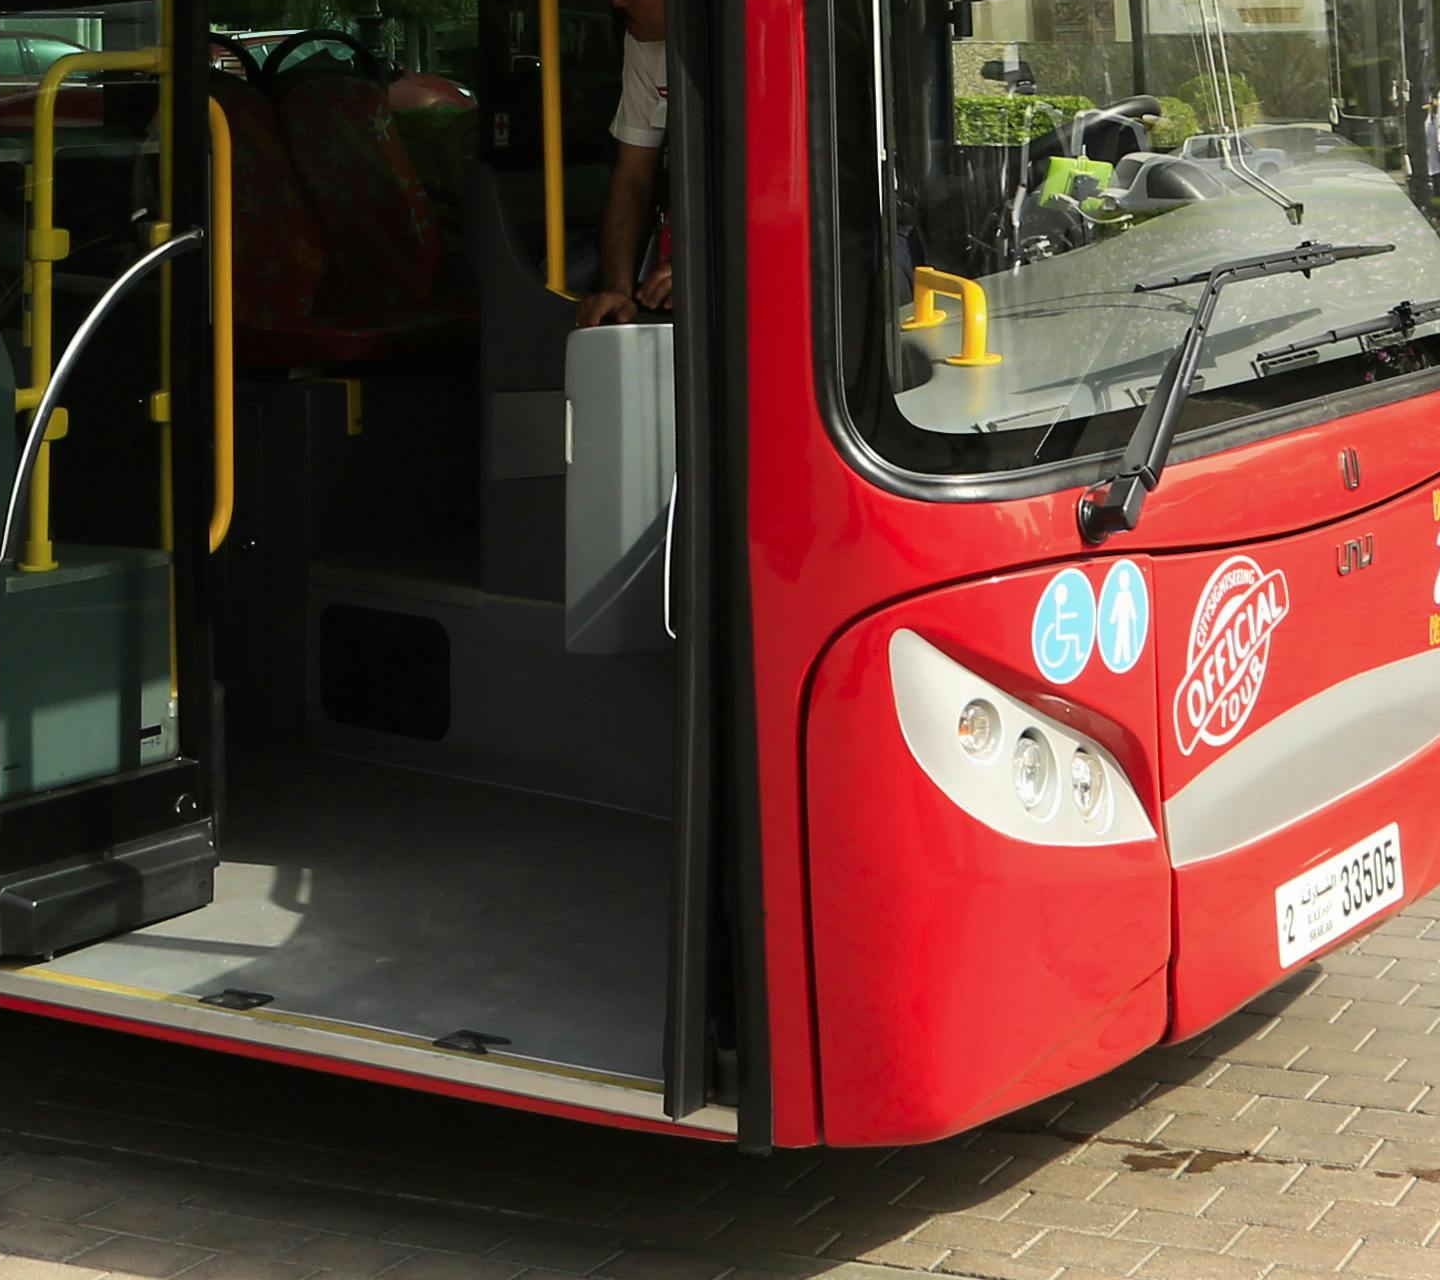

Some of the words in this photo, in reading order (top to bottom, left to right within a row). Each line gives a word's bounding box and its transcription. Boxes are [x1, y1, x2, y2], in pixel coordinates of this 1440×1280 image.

[1187, 581, 1283, 728] OFFICIAL
[1220, 655, 1263, 728] TOUR
[1340, 838, 1396, 917] 33505
